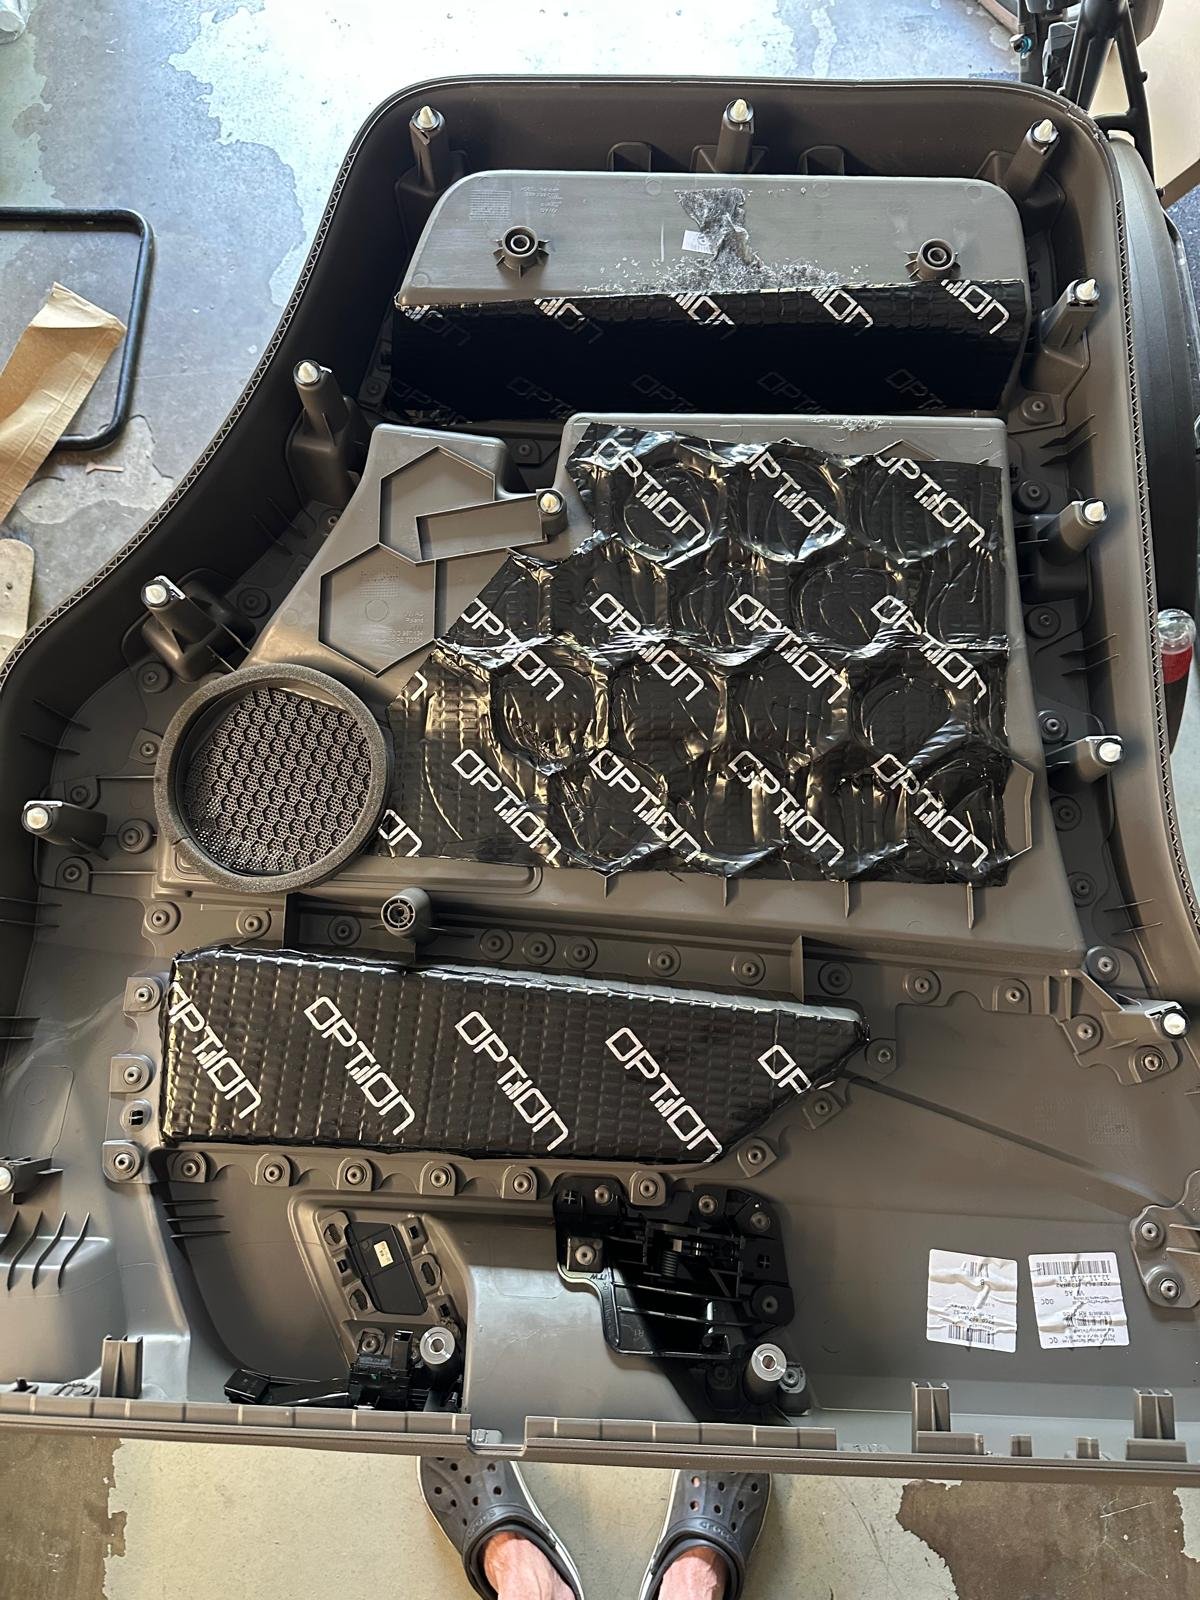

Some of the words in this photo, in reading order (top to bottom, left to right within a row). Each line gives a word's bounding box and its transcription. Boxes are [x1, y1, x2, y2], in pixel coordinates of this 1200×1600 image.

[670, 292, 737, 340] ION
[811, 285, 874, 336] ION
[941, 279, 1010, 334] ION
[597, 438, 706, 548] OPTION
[461, 598, 564, 701] OPTON
[728, 594, 850, 703] OPTION
[871, 595, 987, 704] OPTION
[451, 749, 562, 862] OPTION
[589, 749, 702, 862] OPTION
[728, 751, 844, 867] OPTION
[872, 753, 989, 867] OPTION
[304, 996, 415, 1135] OPTION
[454, 1011, 568, 1151] OPTION
[605, 1027, 722, 1163] OPTION
